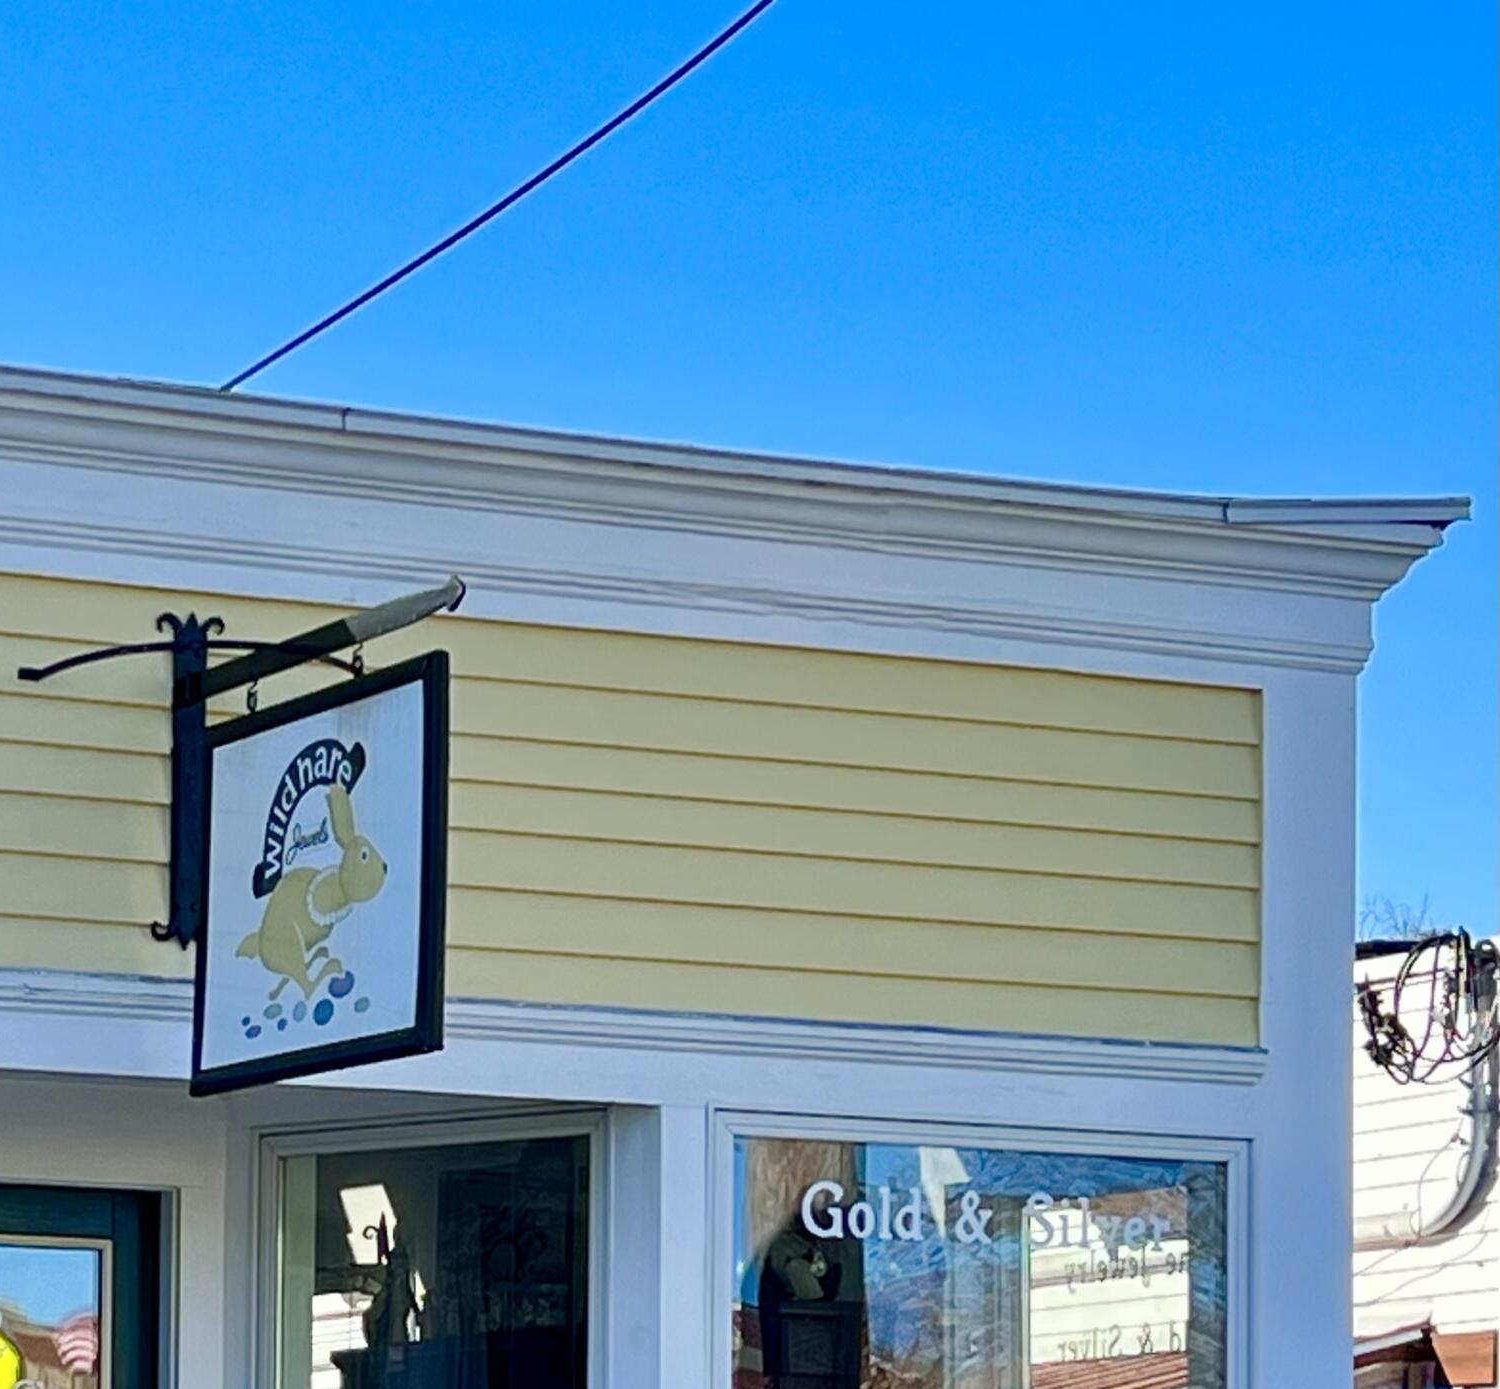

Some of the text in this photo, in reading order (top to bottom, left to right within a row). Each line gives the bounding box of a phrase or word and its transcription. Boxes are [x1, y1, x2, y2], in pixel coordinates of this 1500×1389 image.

[263, 745, 351, 879] wild hare
[801, 1180, 1172, 1252] Gold & Silver
